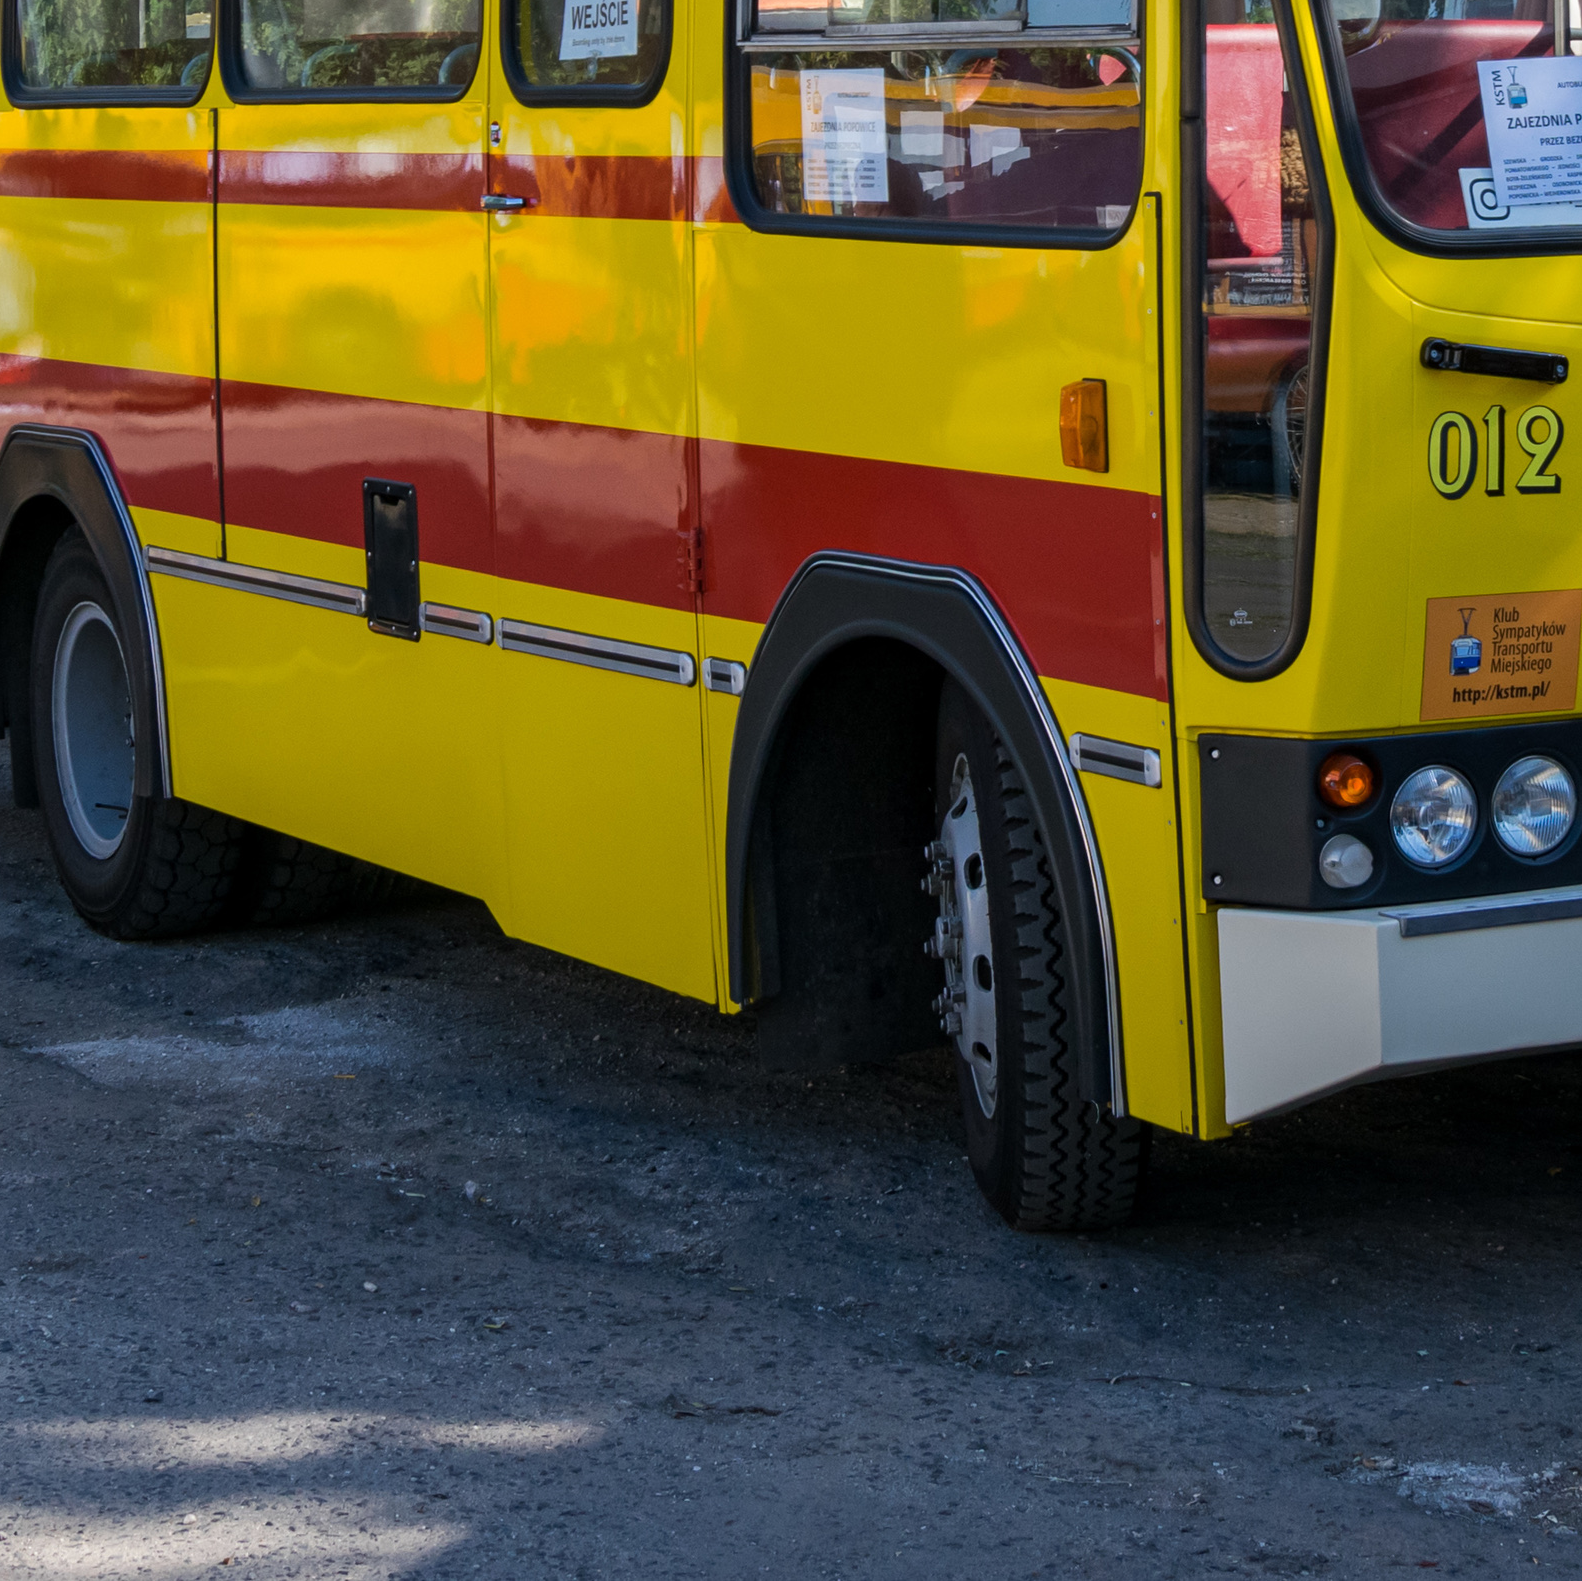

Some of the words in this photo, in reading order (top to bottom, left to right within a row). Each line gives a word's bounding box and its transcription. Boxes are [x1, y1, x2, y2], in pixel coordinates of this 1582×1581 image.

[1491, 70, 1505, 106] KSTM
[1507, 114, 1572, 130] ZAJEZDNIA
[1540, 136, 1565, 146] PRZEZ
[1428, 405, 1564, 500] 012
[1493, 607, 1519, 624] Klub
[1492, 621, 1566, 642] Sympatyków
[1492, 639, 1553, 658] Transportu
[1490, 655, 1552, 675] Miejskiego
[1452, 680, 1550, 703] http://kstm.pl/
